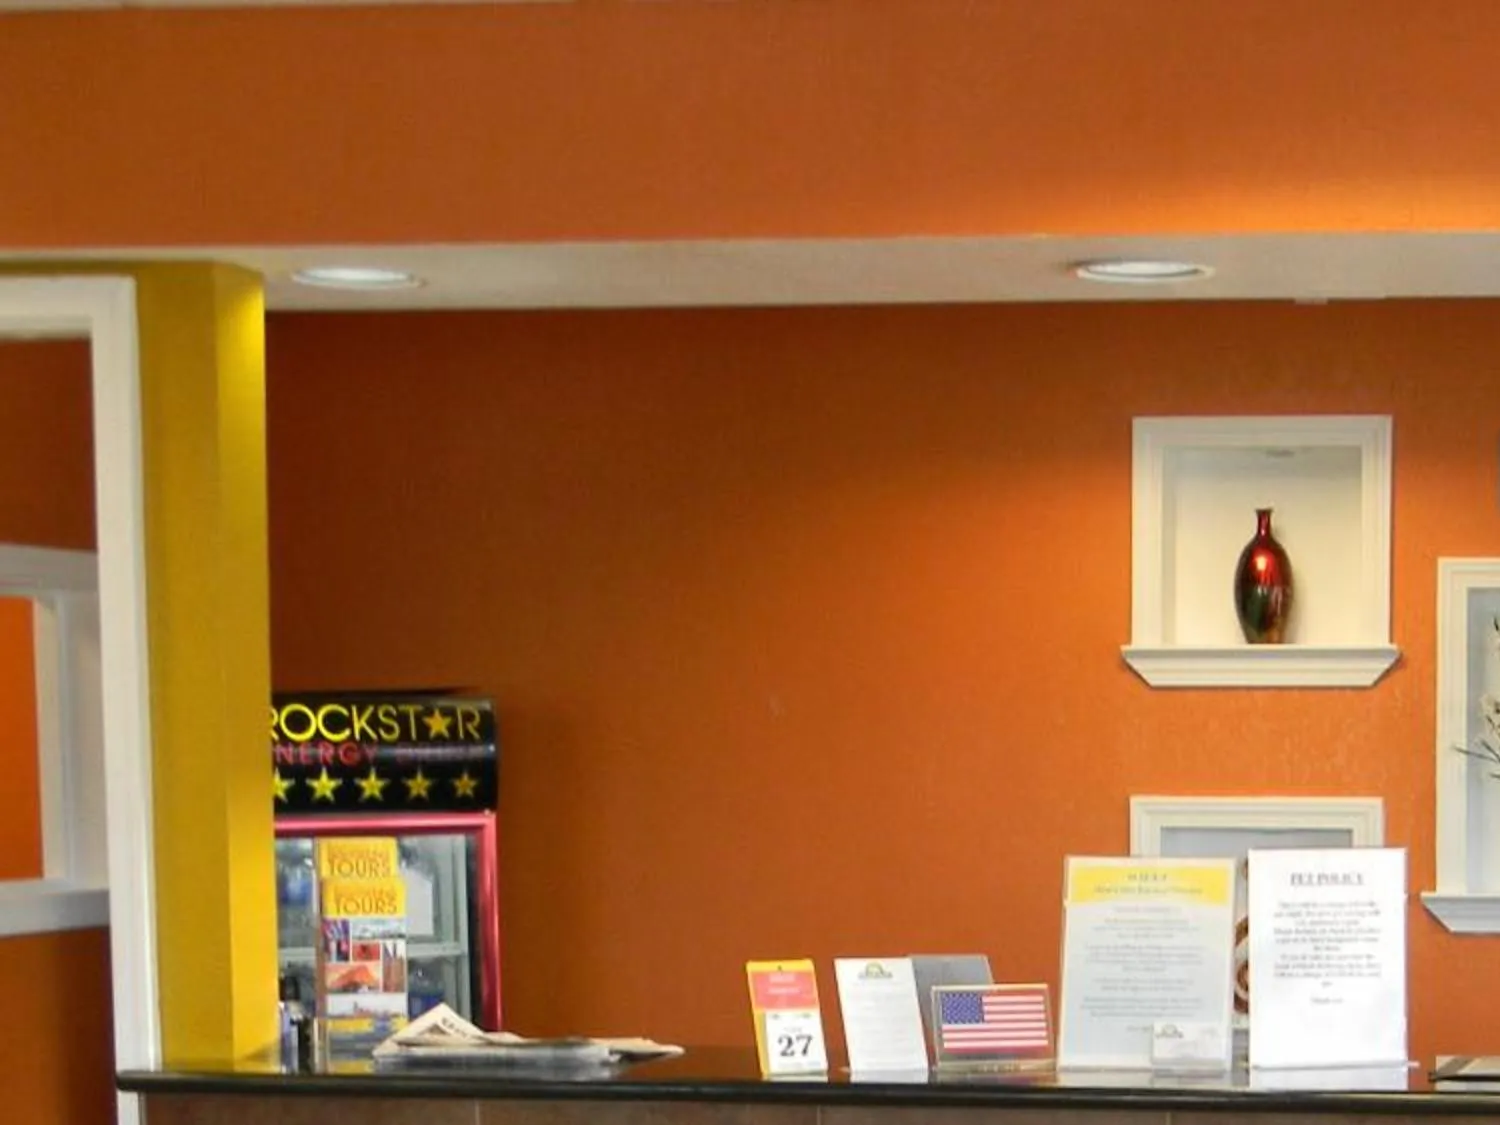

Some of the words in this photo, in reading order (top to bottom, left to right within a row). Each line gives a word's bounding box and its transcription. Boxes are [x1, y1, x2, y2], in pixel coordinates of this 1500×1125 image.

[274, 741, 379, 767] NERGY
[334, 895, 398, 915] TOURS
[777, 1033, 813, 1057] 27
